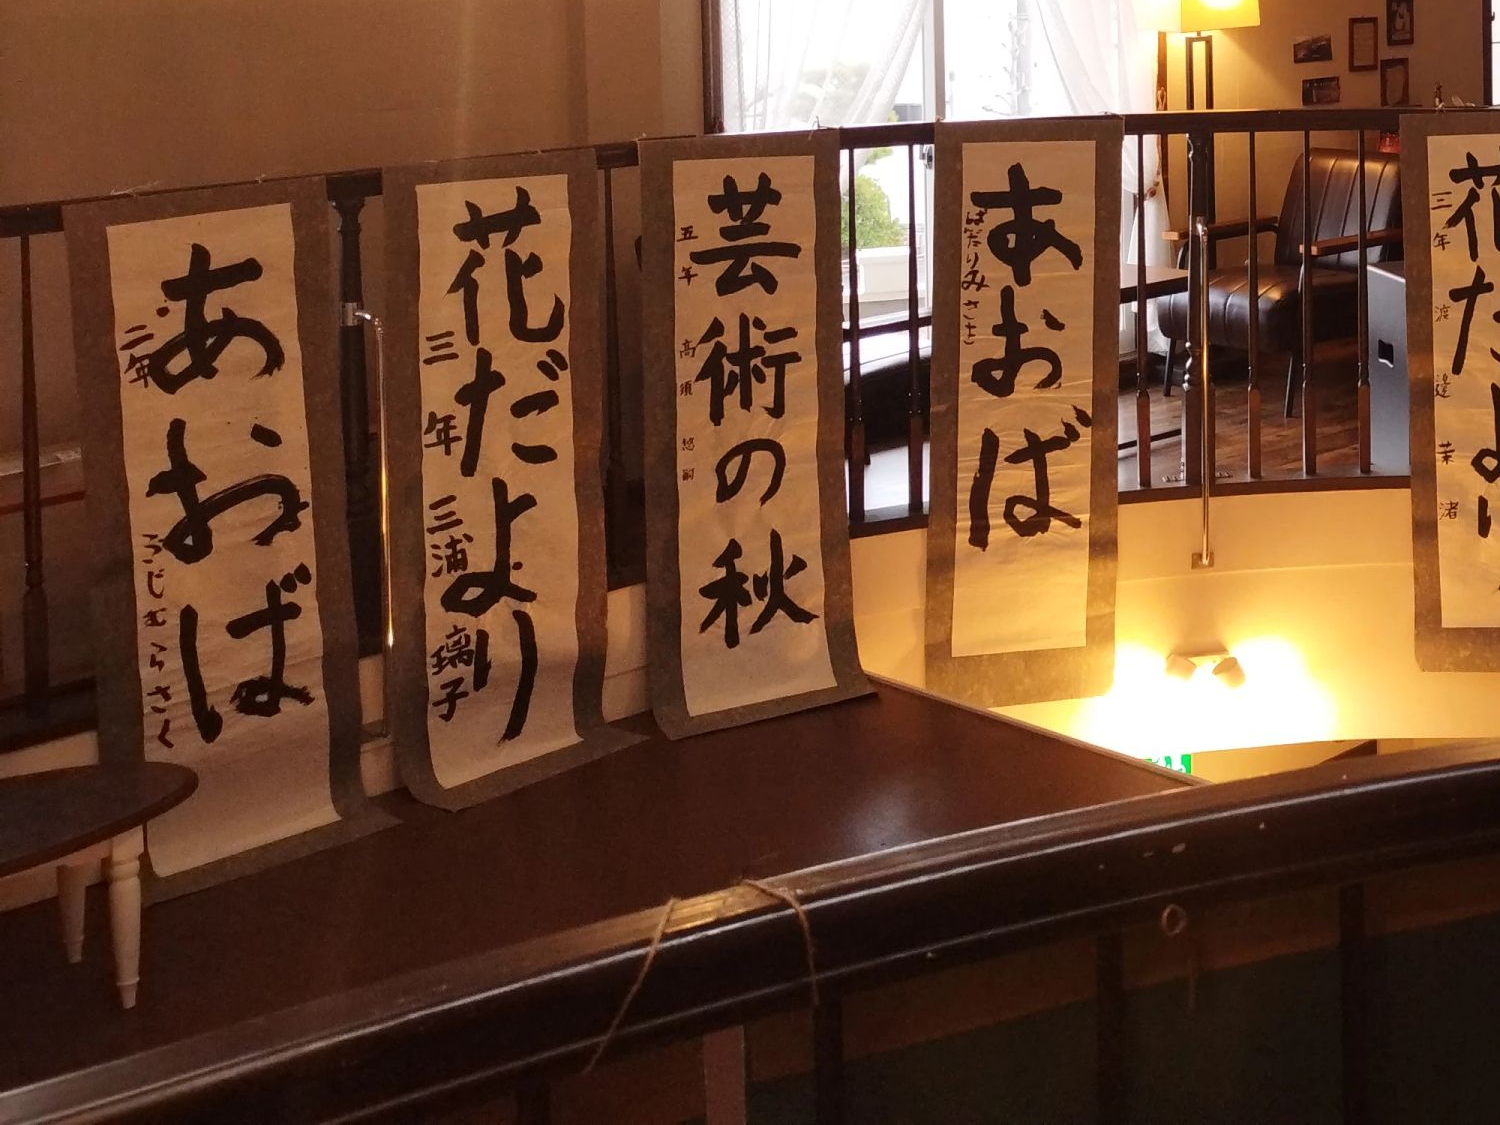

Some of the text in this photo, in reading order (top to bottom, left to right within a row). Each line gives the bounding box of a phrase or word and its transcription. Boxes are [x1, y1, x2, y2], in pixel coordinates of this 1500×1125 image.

[144, 243, 313, 743] あおば
[440, 185, 569, 744] 花だより
[690, 172, 819, 650] 芸術の秋
[969, 162, 1092, 552] あおば
